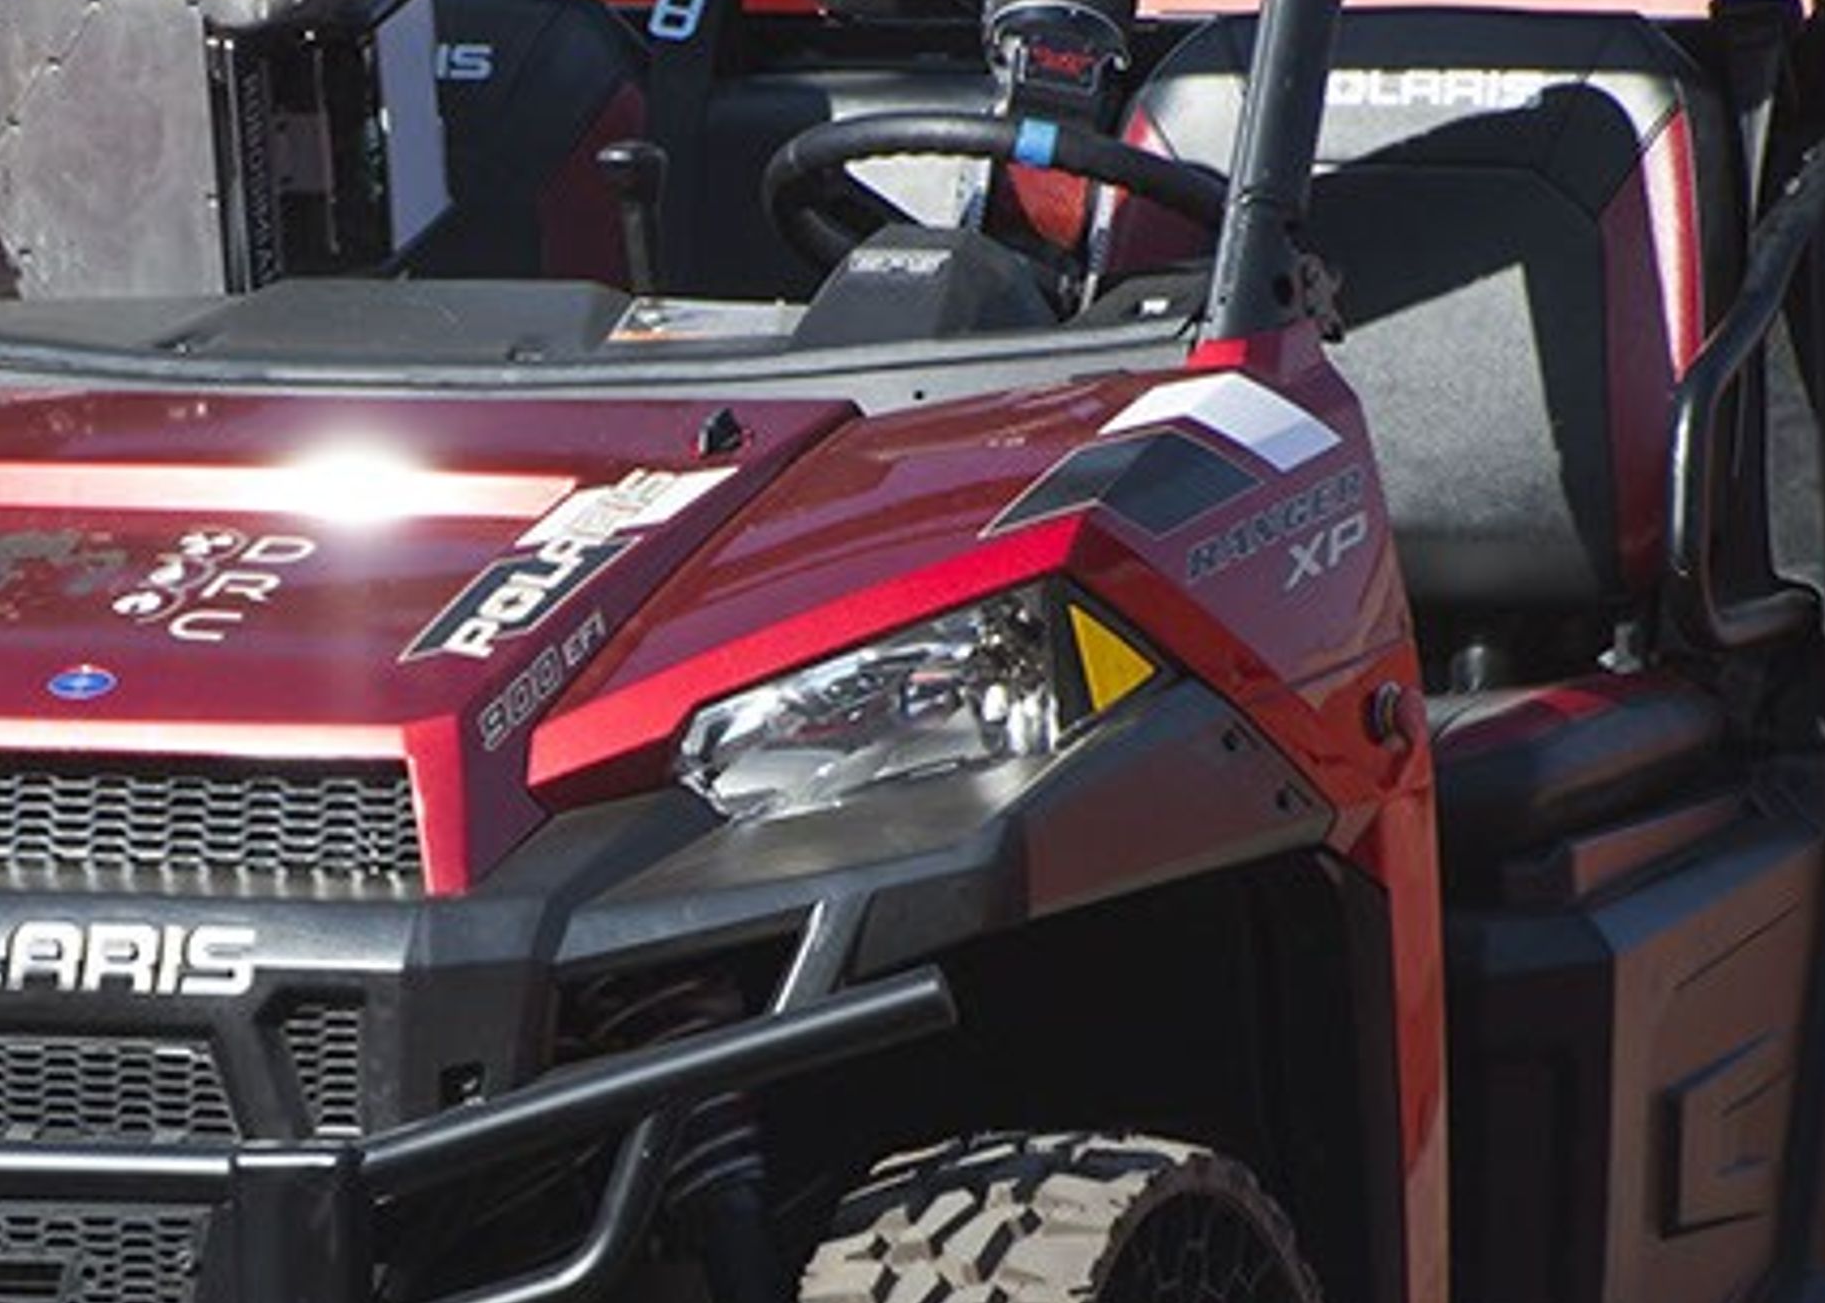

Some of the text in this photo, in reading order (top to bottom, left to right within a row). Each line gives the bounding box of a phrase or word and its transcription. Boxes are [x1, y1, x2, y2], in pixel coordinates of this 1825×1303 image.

[1327, 68, 1544, 108] OLARIS
[441, 468, 676, 658] POLARIS
[1187, 463, 1364, 587] RANGER
[1284, 510, 1368, 591] XP
[480, 608, 608, 751] 900 EFI
